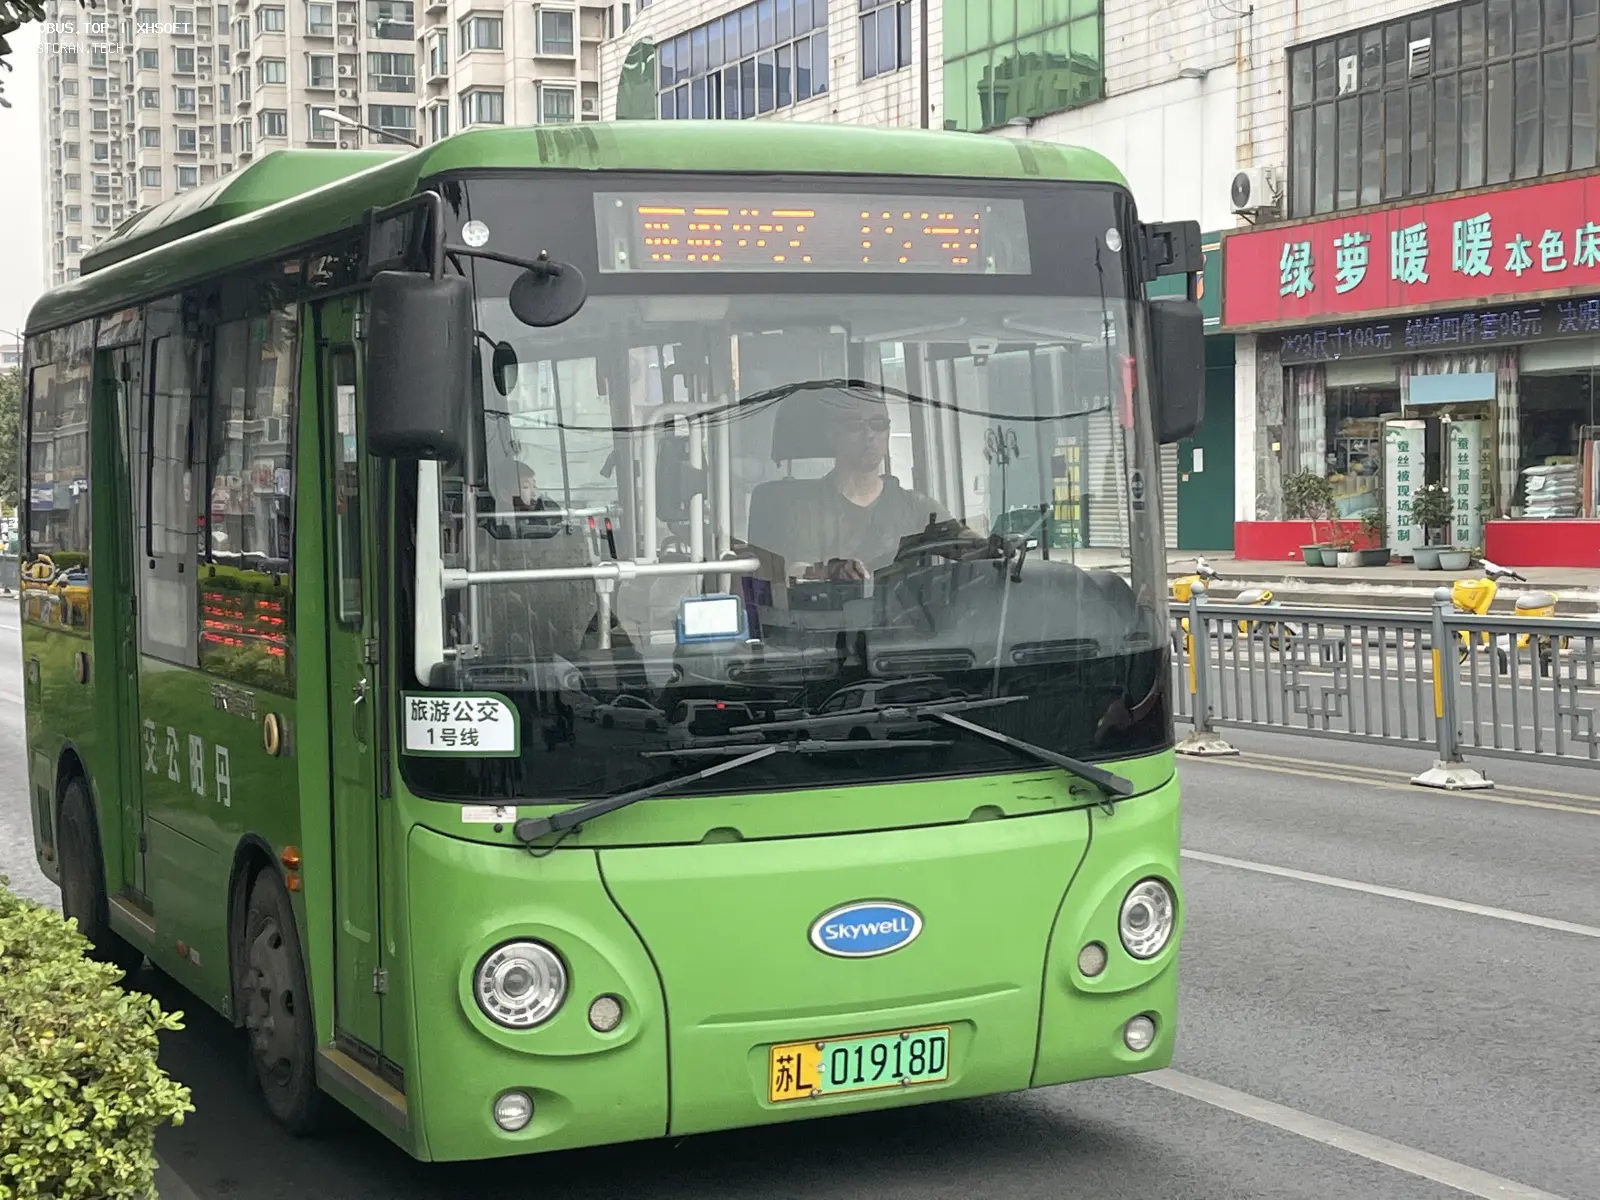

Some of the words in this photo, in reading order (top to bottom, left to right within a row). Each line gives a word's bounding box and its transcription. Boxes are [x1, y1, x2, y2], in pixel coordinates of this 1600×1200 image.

[1396, 440, 1410, 541] 蚕丝被现场拉制
[1457, 437, 1470, 541] 蚕丝被现场拉制
[411, 699, 499, 722] 旅游公交
[426, 728, 480, 747] 1号线
[825, 916, 909, 940] Skywell
